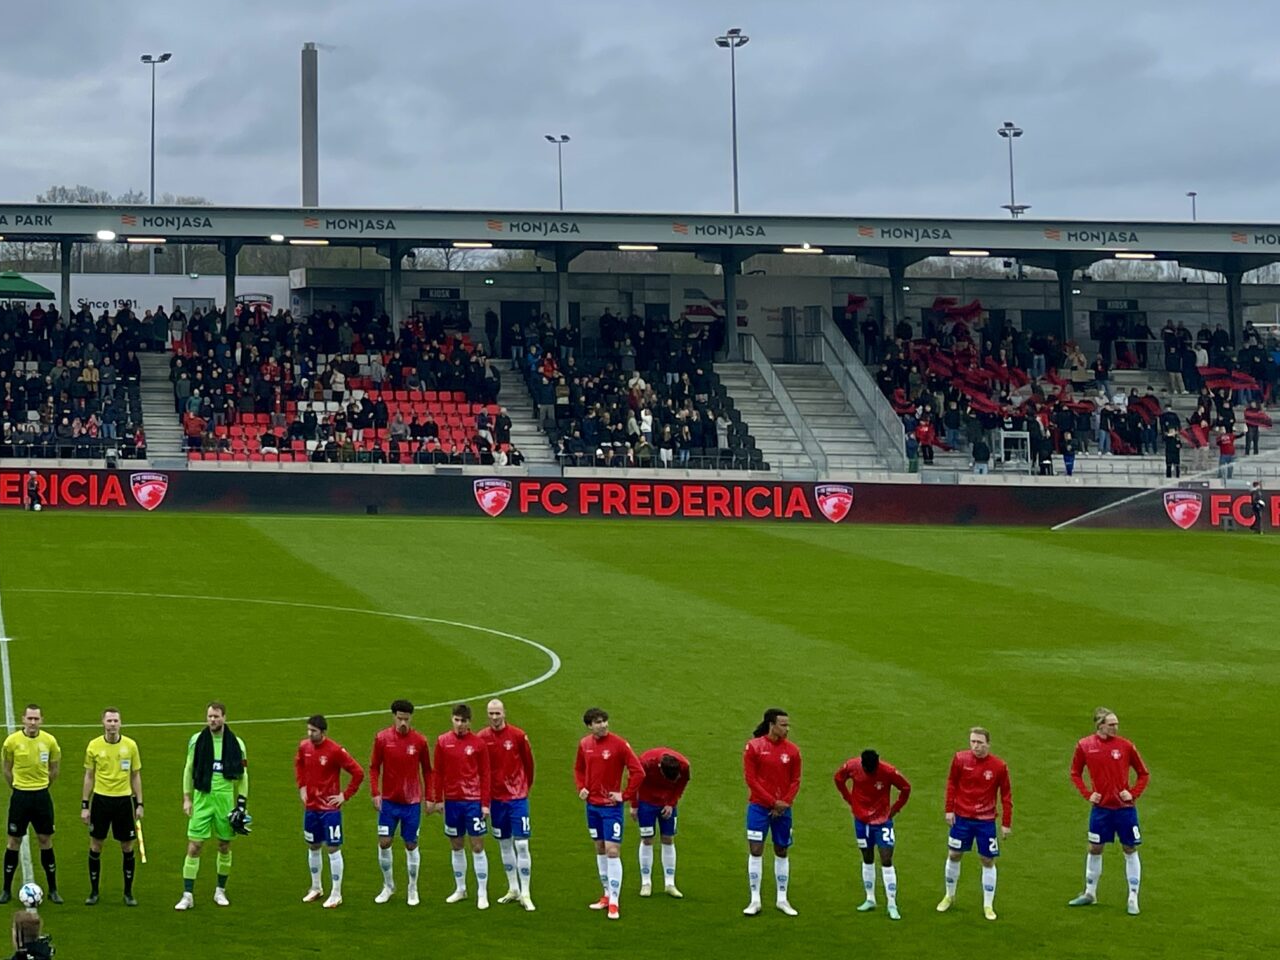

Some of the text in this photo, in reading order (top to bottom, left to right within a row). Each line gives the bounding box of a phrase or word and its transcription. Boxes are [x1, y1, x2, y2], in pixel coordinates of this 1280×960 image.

[15, 215, 54, 226] PARK
[142, 217, 214, 231] MONJASA
[325, 219, 397, 234] MONJASA
[509, 222, 581, 236] MONJASA
[694, 225, 766, 240] MONJASA
[880, 228, 953, 242] MONJASA
[1066, 231, 1140, 246] MONJASA
[429, 289, 451, 298] KIOSK
[519, 482, 811, 518] FC FREDERICIA
[1210, 494, 1257, 527] FC
[329, 824, 342, 840] 14
[613, 822, 621, 837] 9
[1132, 825, 1141, 840] 8
